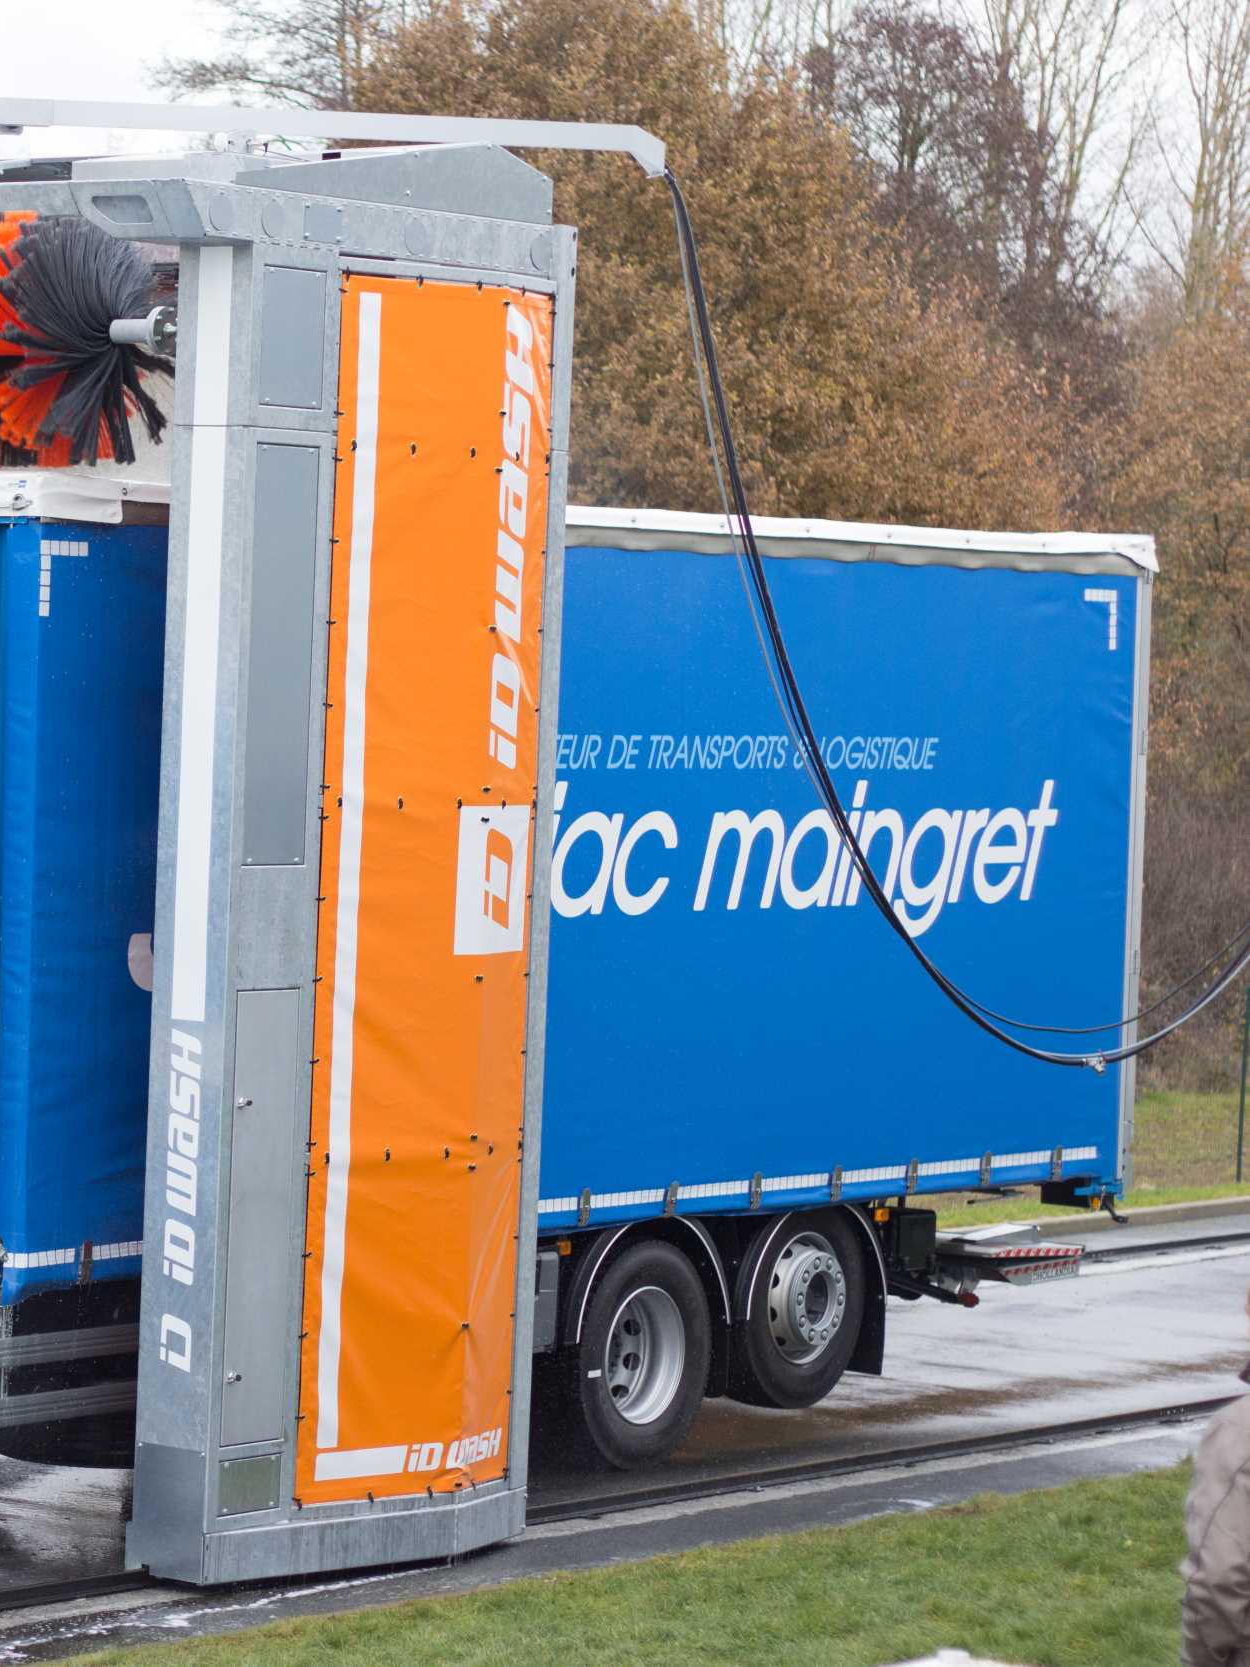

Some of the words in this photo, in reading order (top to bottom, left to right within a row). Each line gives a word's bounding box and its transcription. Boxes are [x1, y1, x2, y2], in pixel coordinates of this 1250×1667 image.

[606, 734, 642, 770] DE
[648, 734, 789, 770] TRANSPORTS
[693, 779, 1059, 939] maingret
